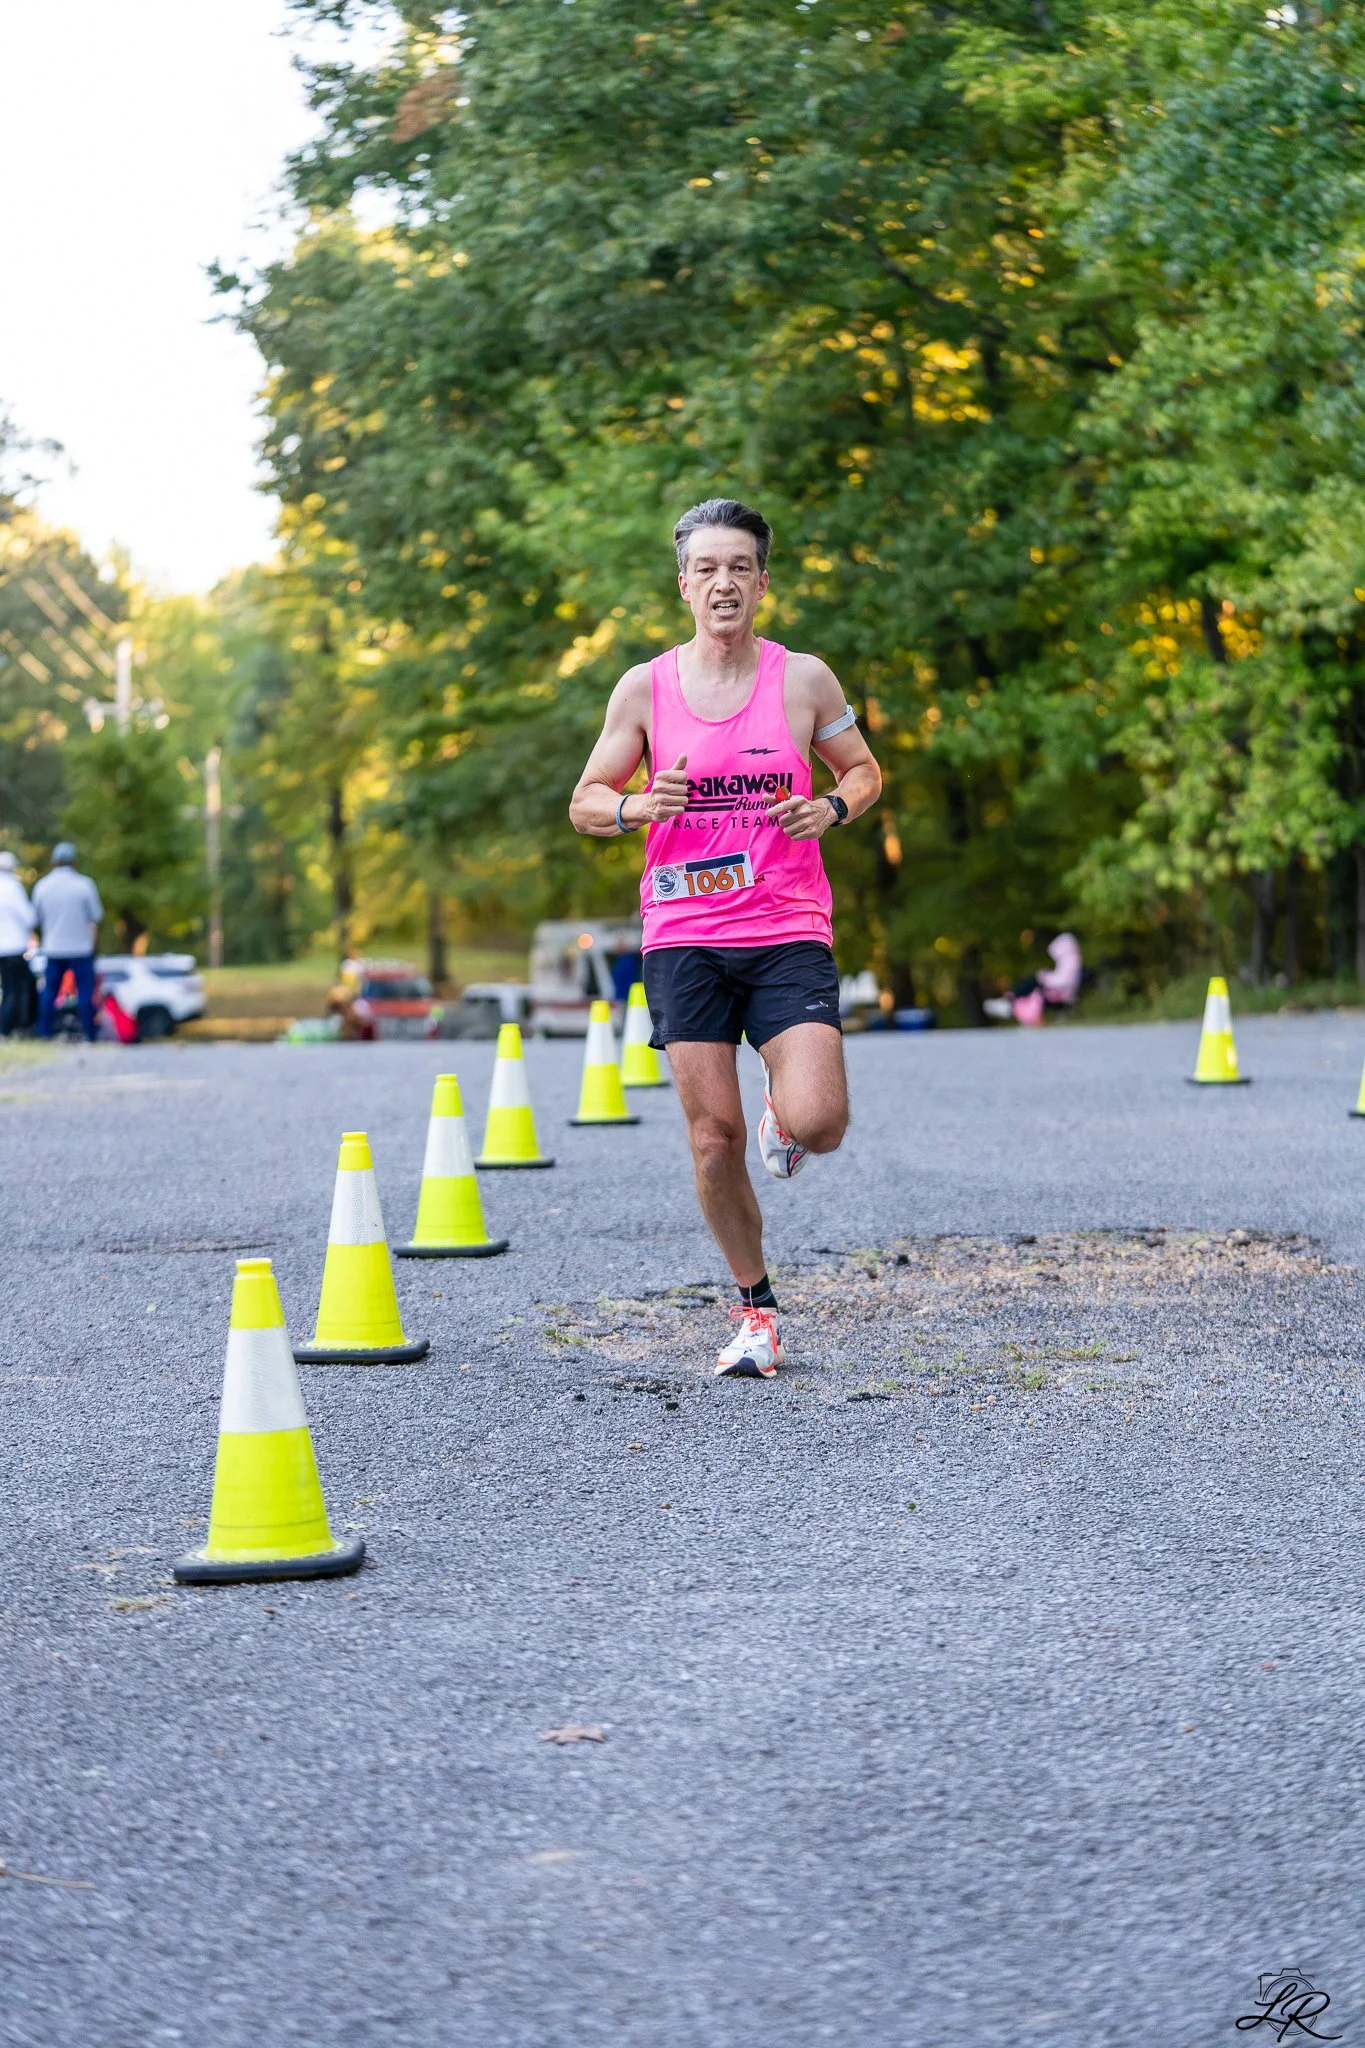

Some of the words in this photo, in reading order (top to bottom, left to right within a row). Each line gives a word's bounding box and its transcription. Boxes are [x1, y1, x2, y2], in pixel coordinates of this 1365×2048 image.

[686, 772, 793, 798] eakaway
[673, 817, 719, 830] RACE
[731, 815, 780, 829] TEAM
[683, 864, 746, 896] 1061
